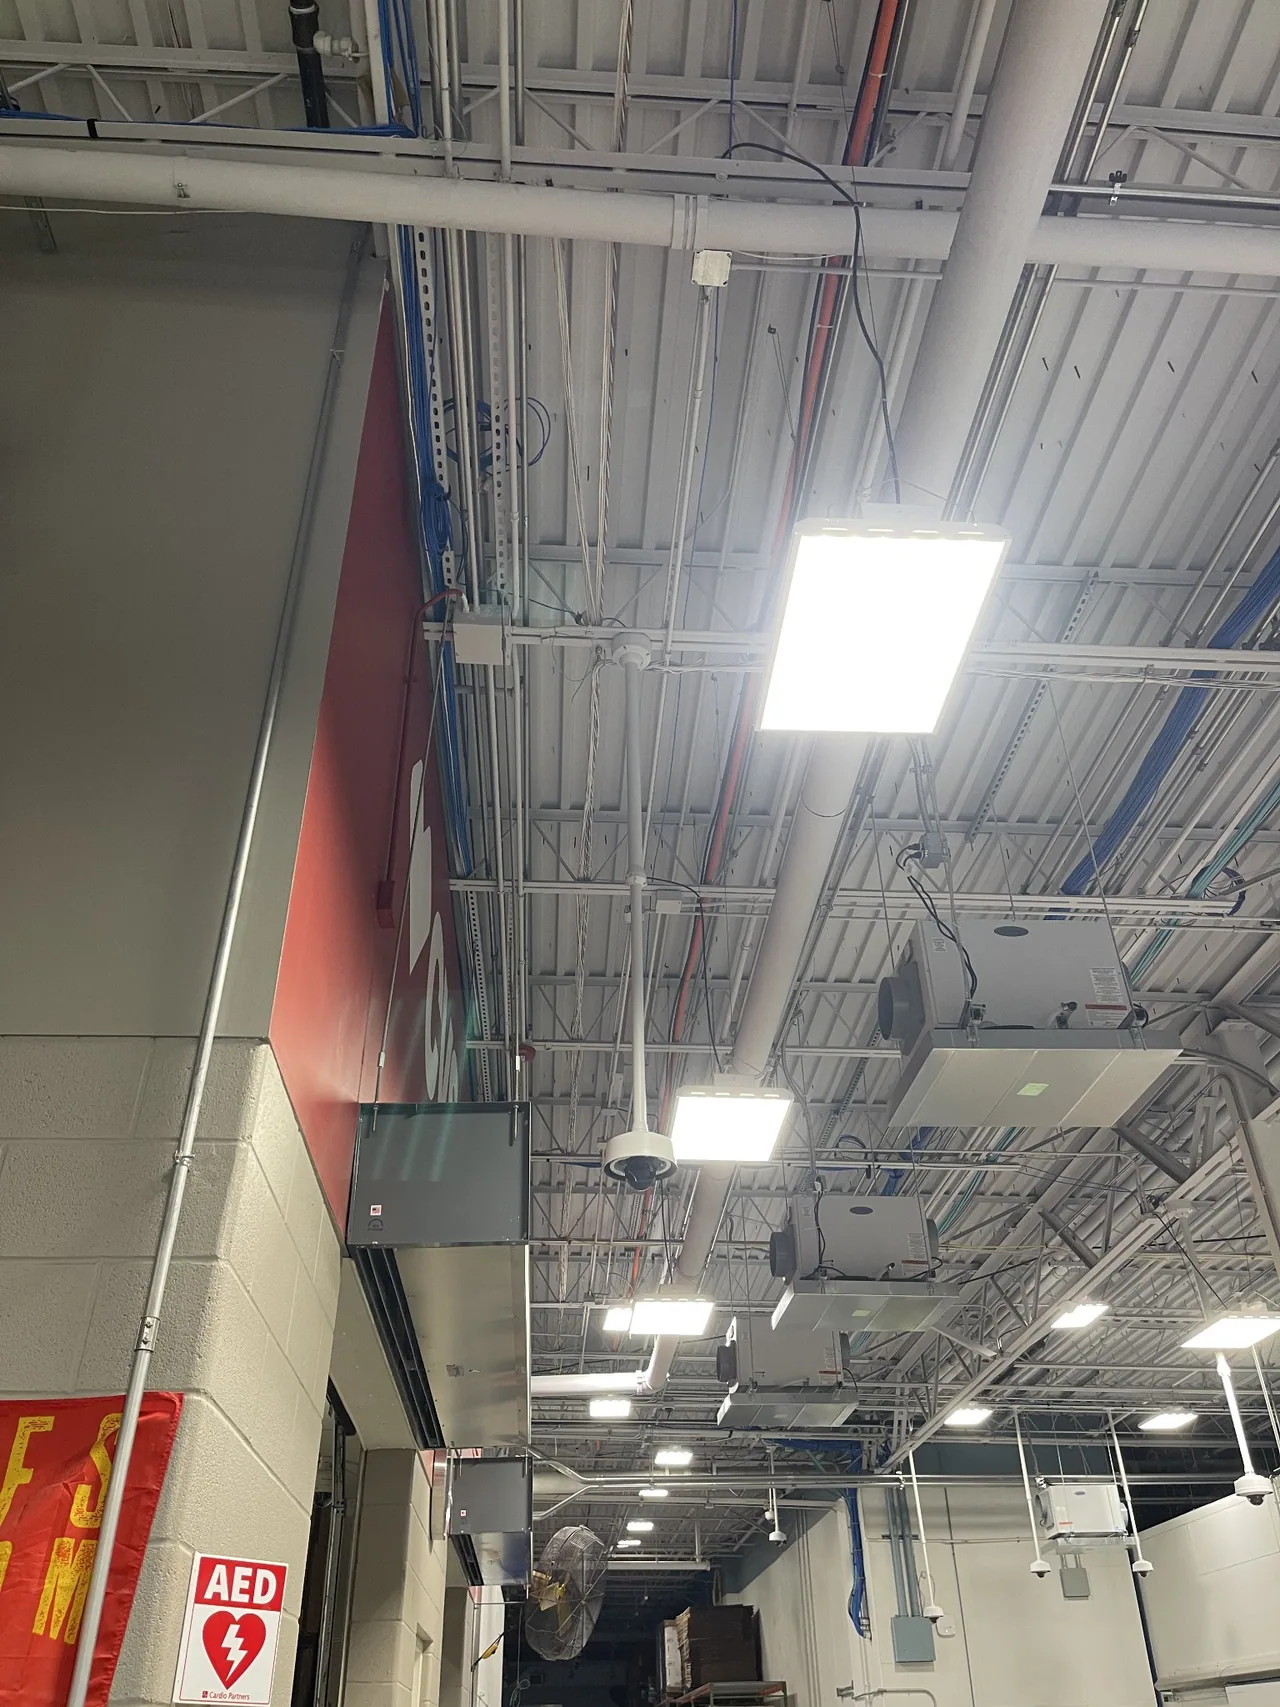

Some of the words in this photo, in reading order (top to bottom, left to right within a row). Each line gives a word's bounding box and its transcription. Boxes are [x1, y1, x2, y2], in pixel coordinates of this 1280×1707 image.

[203, 1563, 277, 1605] AED
[209, 1691, 227, 1699] Cardio
[228, 1692, 250, 1700] Partners
